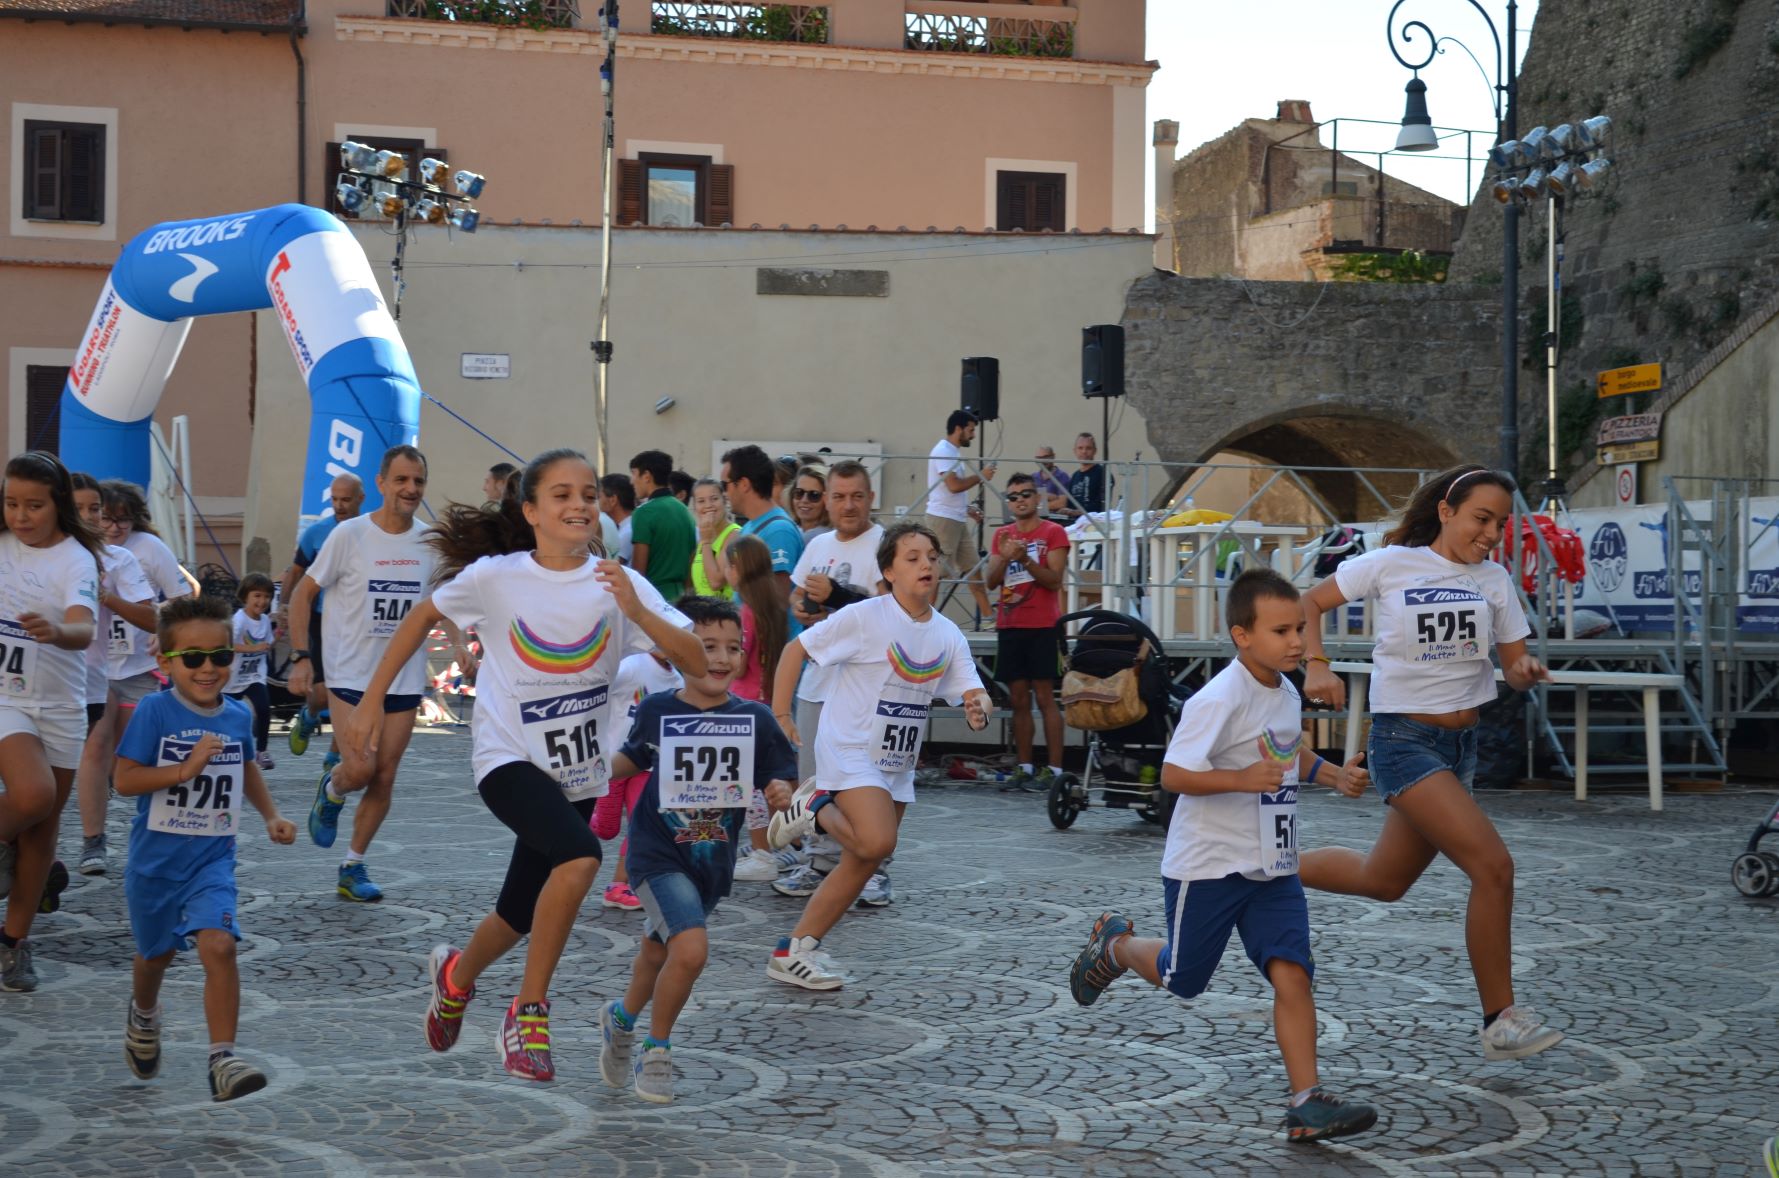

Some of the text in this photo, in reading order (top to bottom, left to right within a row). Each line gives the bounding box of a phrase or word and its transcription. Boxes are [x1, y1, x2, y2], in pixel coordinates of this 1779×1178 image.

[143, 214, 255, 254] BROOKS
[97, 289, 116, 330] SPORT
[79, 357, 100, 397] RUNNING
[97, 304, 122, 353] TRIATHLON
[1609, 415, 1658, 429] PIZZERIA
[1433, 591, 1483, 602] MIZUNO
[373, 598, 412, 621] 544
[1417, 609, 1476, 644] 525
[1421, 651, 1457, 662] Matteo
[556, 692, 607, 715] MIZUNO
[897, 707, 928, 717] MIZUNO
[693, 721, 751, 734] MIZUNO
[881, 723, 919, 752] 518
[544, 718, 600, 770] 516
[209, 752, 240, 762] IZUNO
[674, 746, 740, 782] 523
[166, 774, 233, 810] 526
[559, 775, 590, 788] atteo
[677, 792, 718, 804] Matteo
[167, 818, 209, 830] Matteo
[1274, 813, 1297, 849] 51
